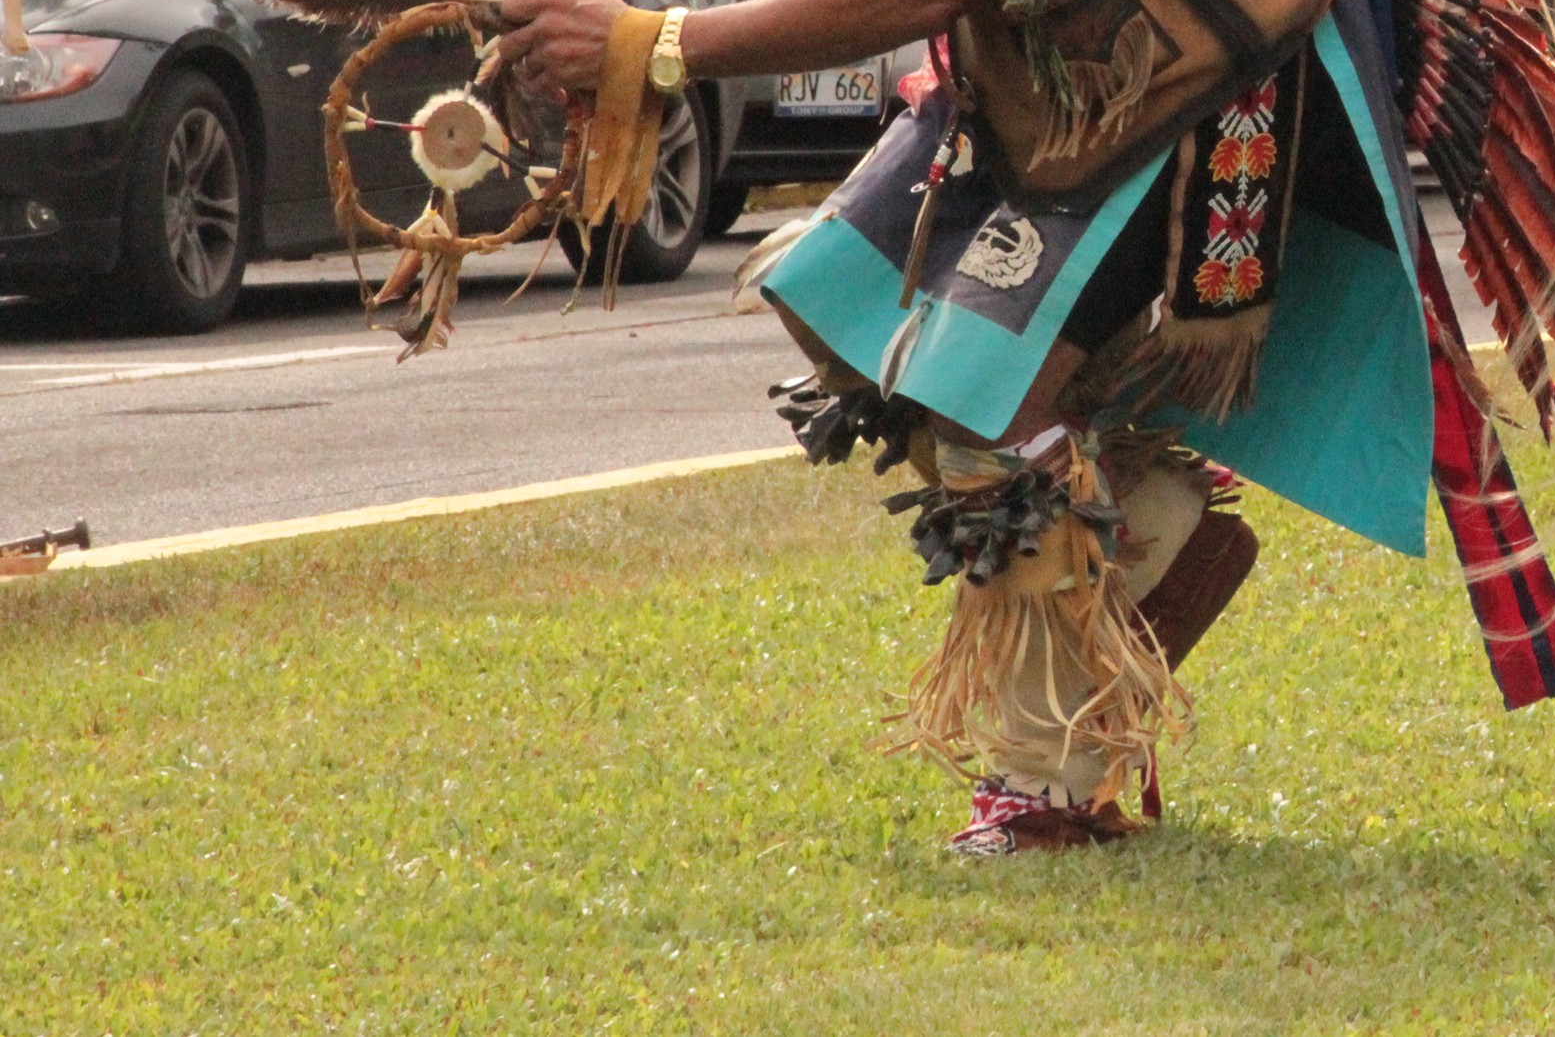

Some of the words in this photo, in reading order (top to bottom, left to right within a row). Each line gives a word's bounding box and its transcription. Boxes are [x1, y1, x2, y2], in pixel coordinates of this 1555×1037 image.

[780, 73, 820, 101] RJV
[835, 72, 875, 101] 662
[827, 106, 864, 115] GROUP
